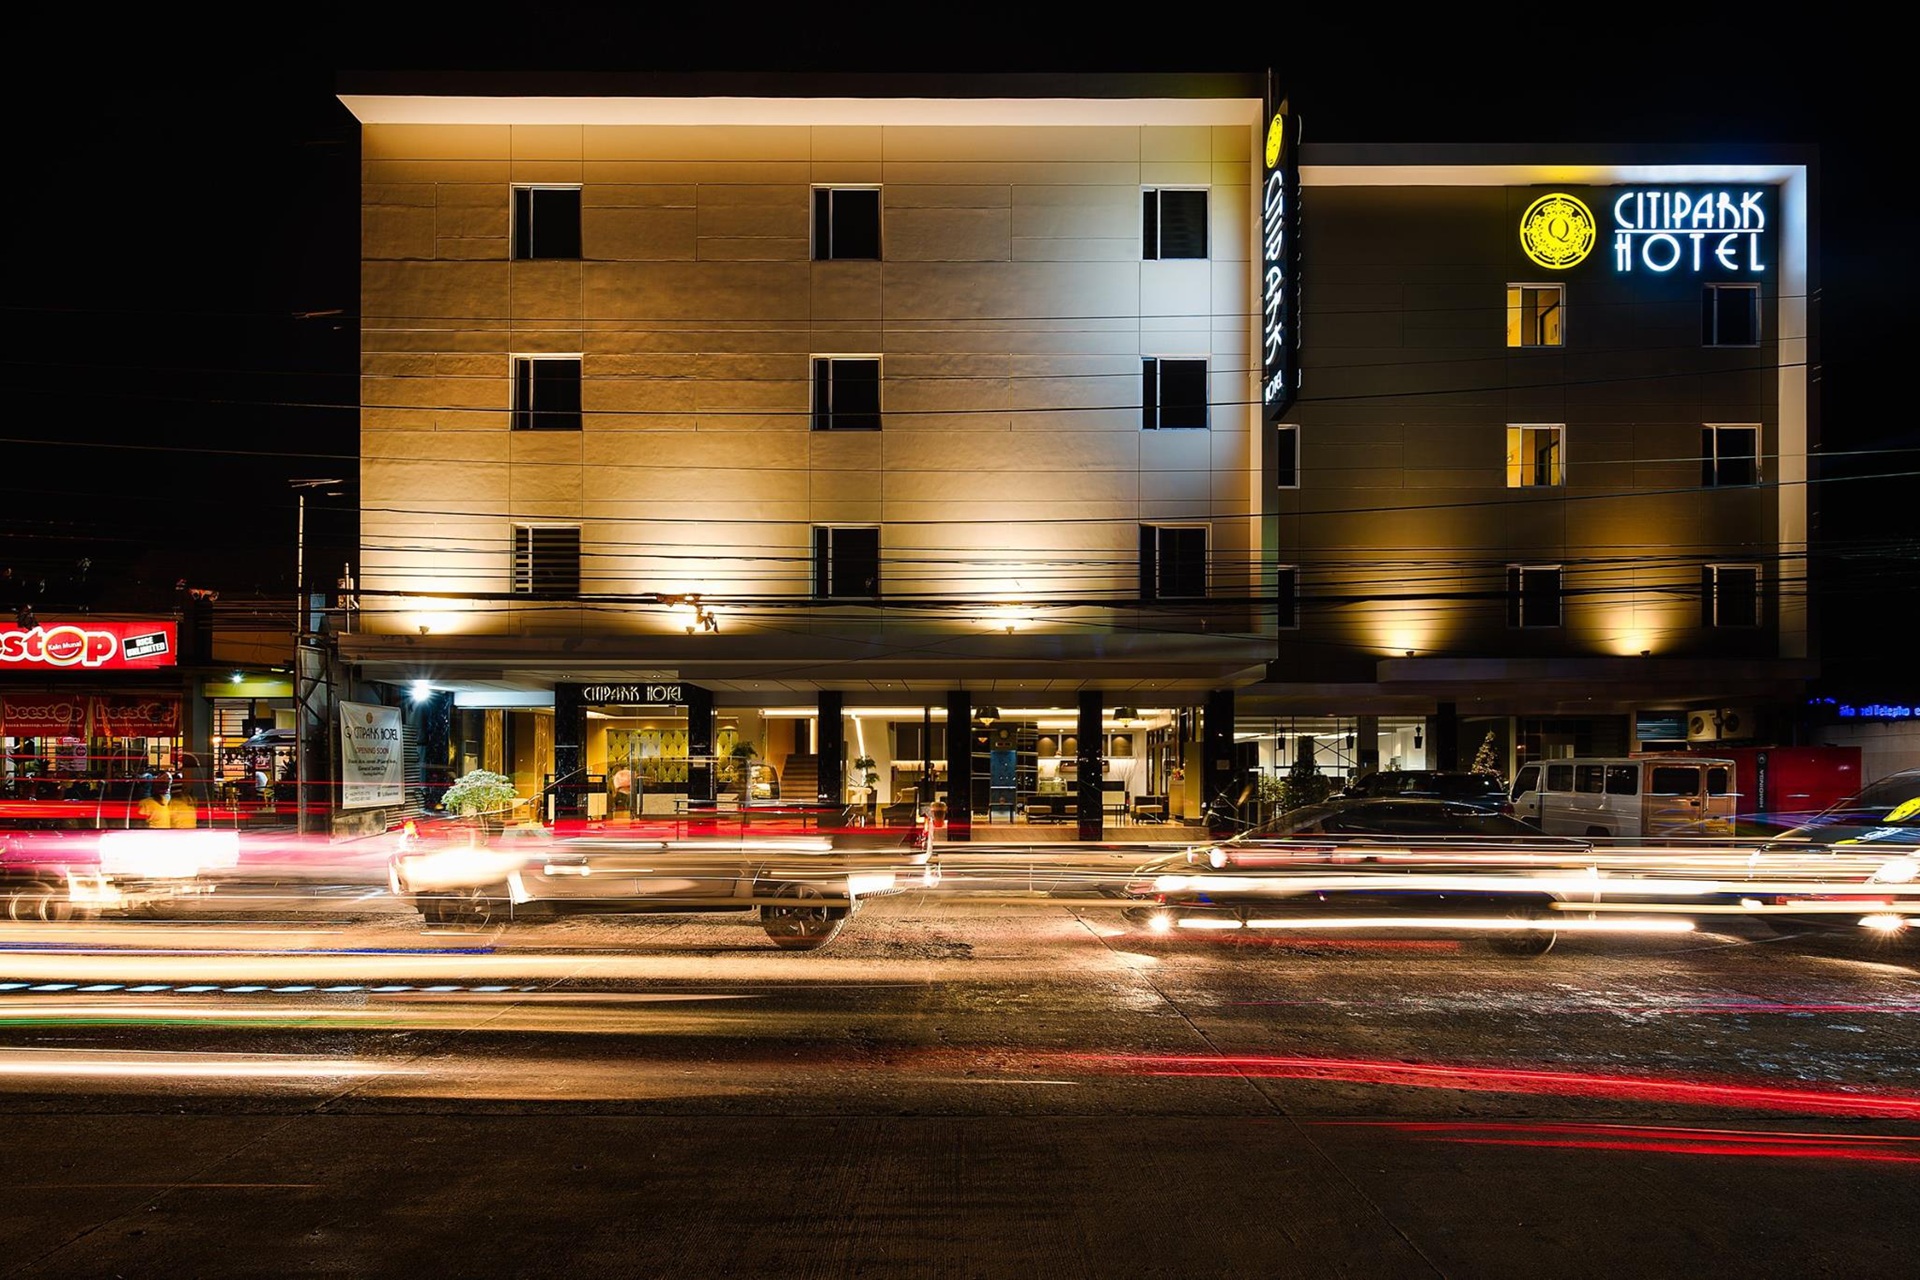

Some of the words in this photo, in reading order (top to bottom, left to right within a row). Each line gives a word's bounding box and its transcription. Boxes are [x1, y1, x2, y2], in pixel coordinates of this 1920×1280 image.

[1614, 191, 1765, 229] CITIPARK
[1265, 170, 1283, 365] CITIPARK
[1614, 233, 1765, 271] HOTEL
[583, 686, 640, 701] CITIPARK
[646, 685, 683, 701] HOTEL
[380, 728, 398, 741] HOTEL
